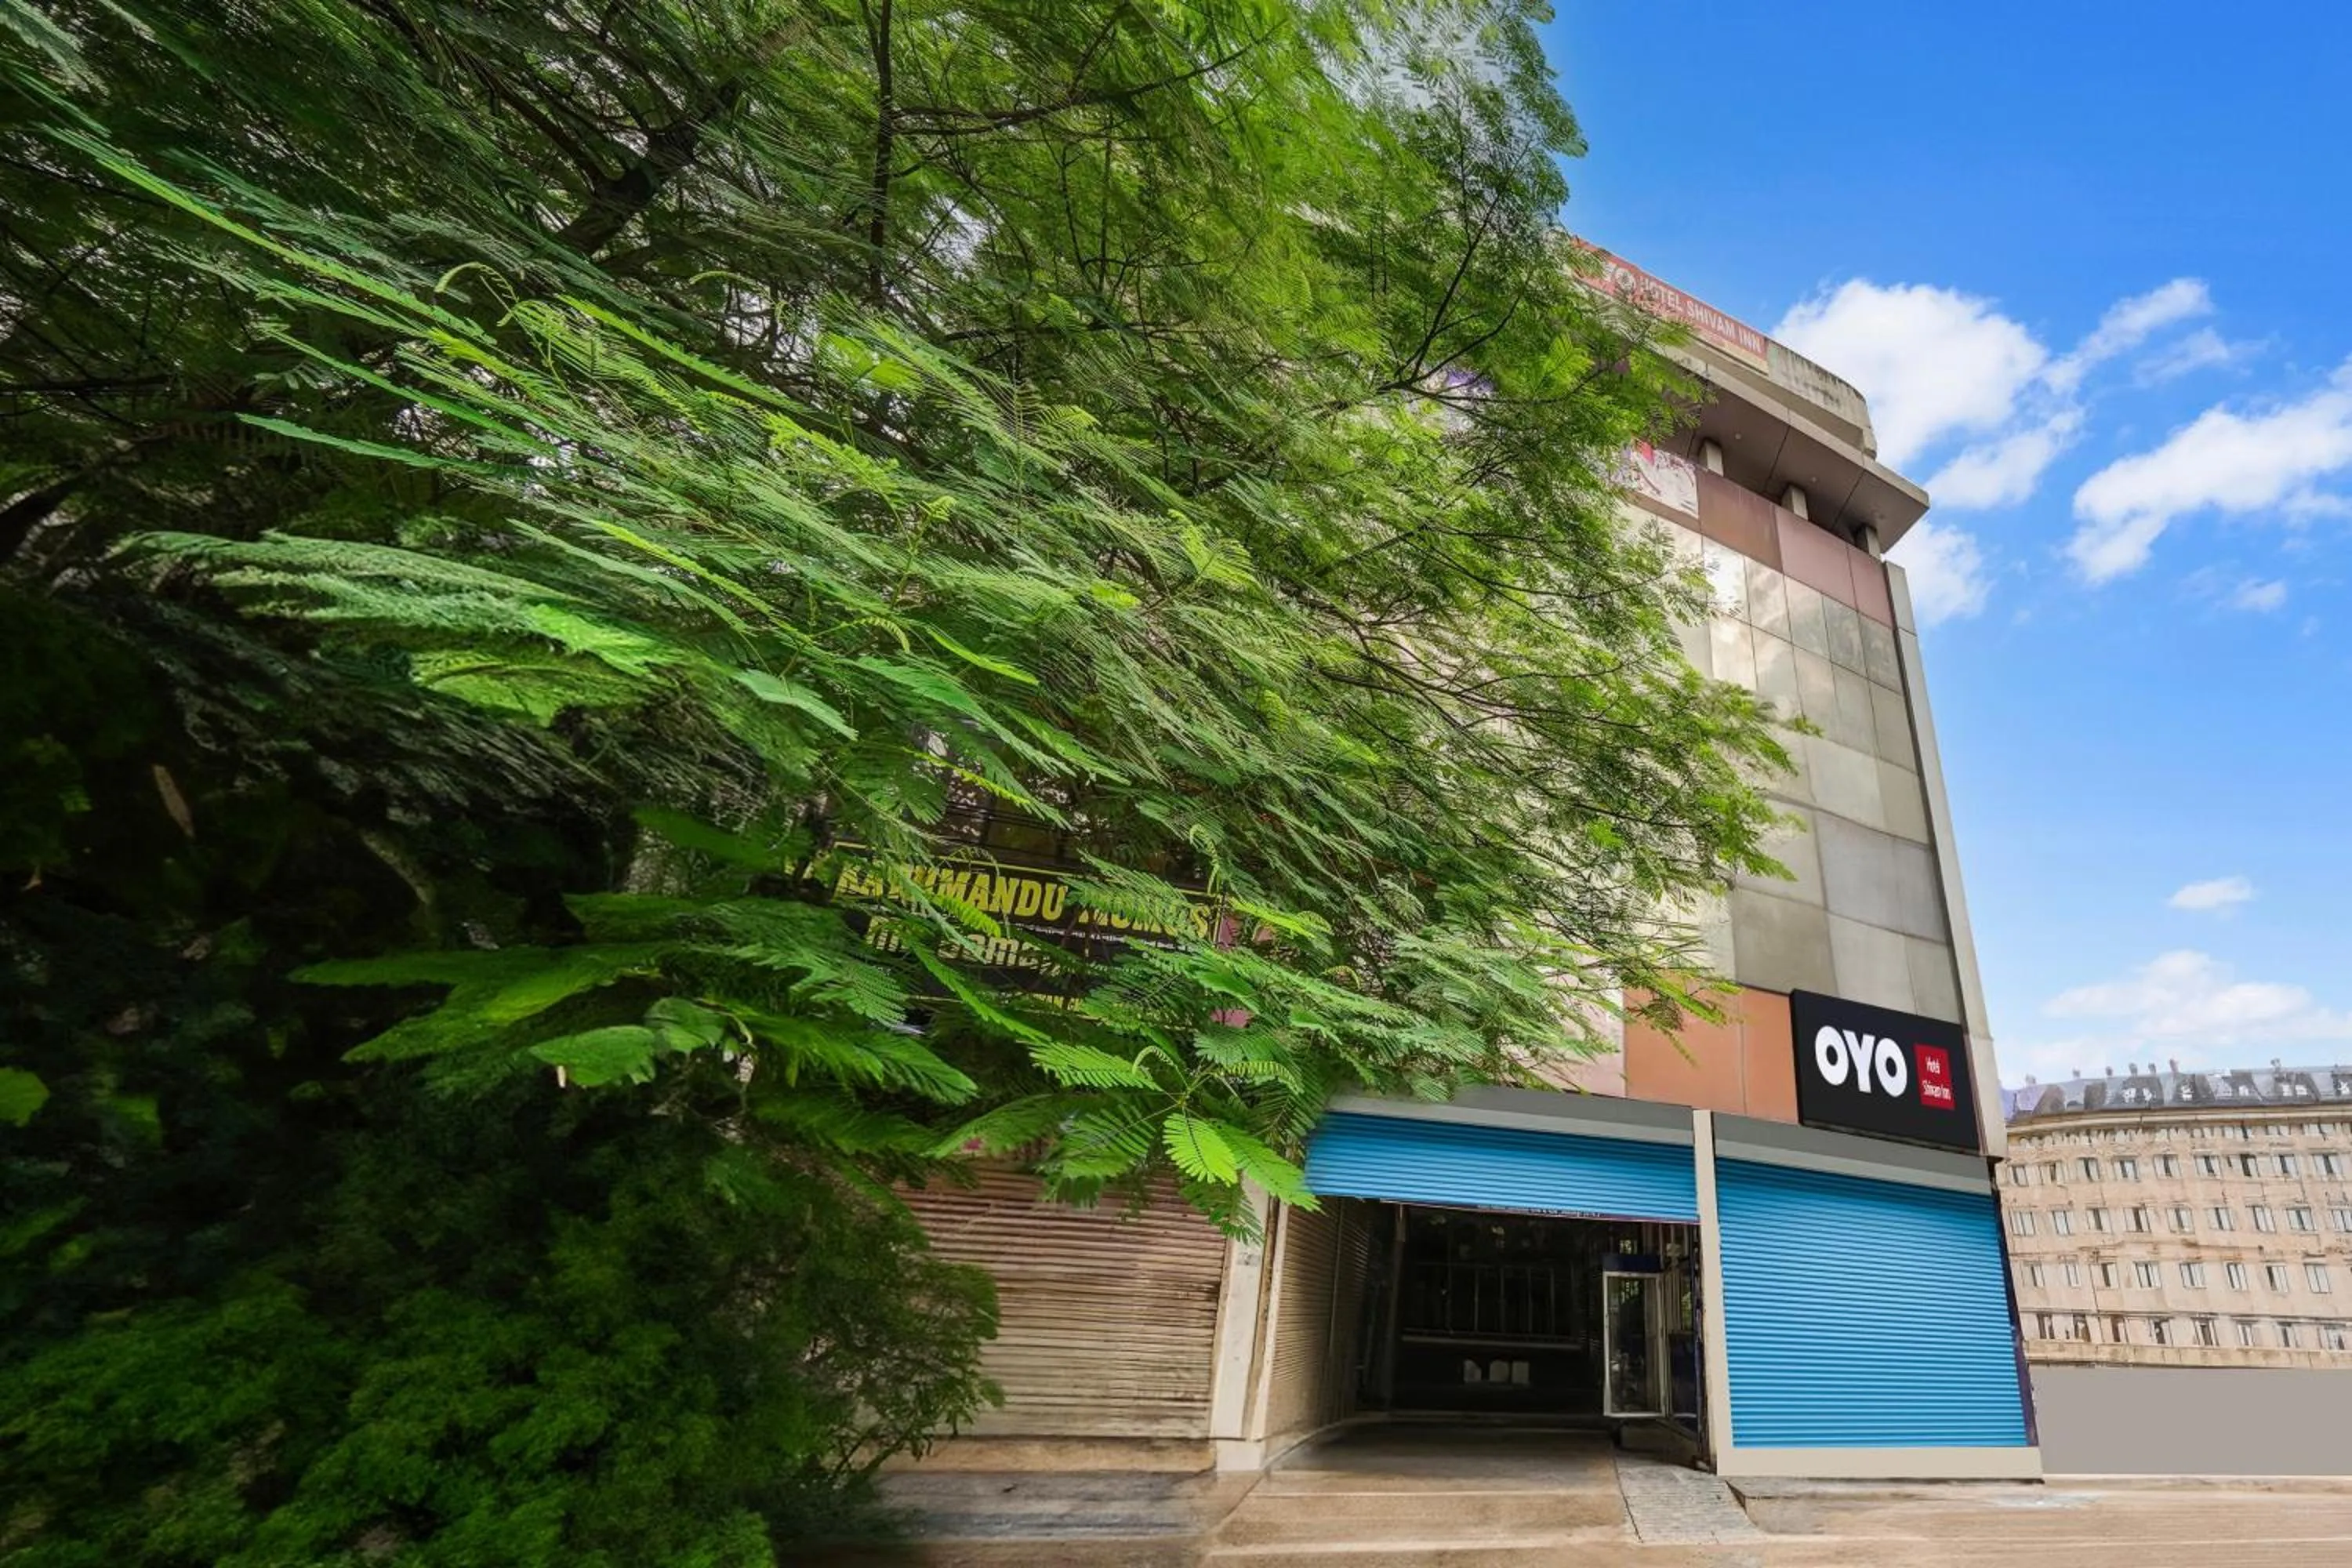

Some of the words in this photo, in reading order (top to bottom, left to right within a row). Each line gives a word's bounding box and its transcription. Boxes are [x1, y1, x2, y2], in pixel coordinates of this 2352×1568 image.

[1686, 299, 1736, 339] SHIVAM
[1738, 325, 1763, 354] INN
[1815, 1025, 1907, 1097] OYO
